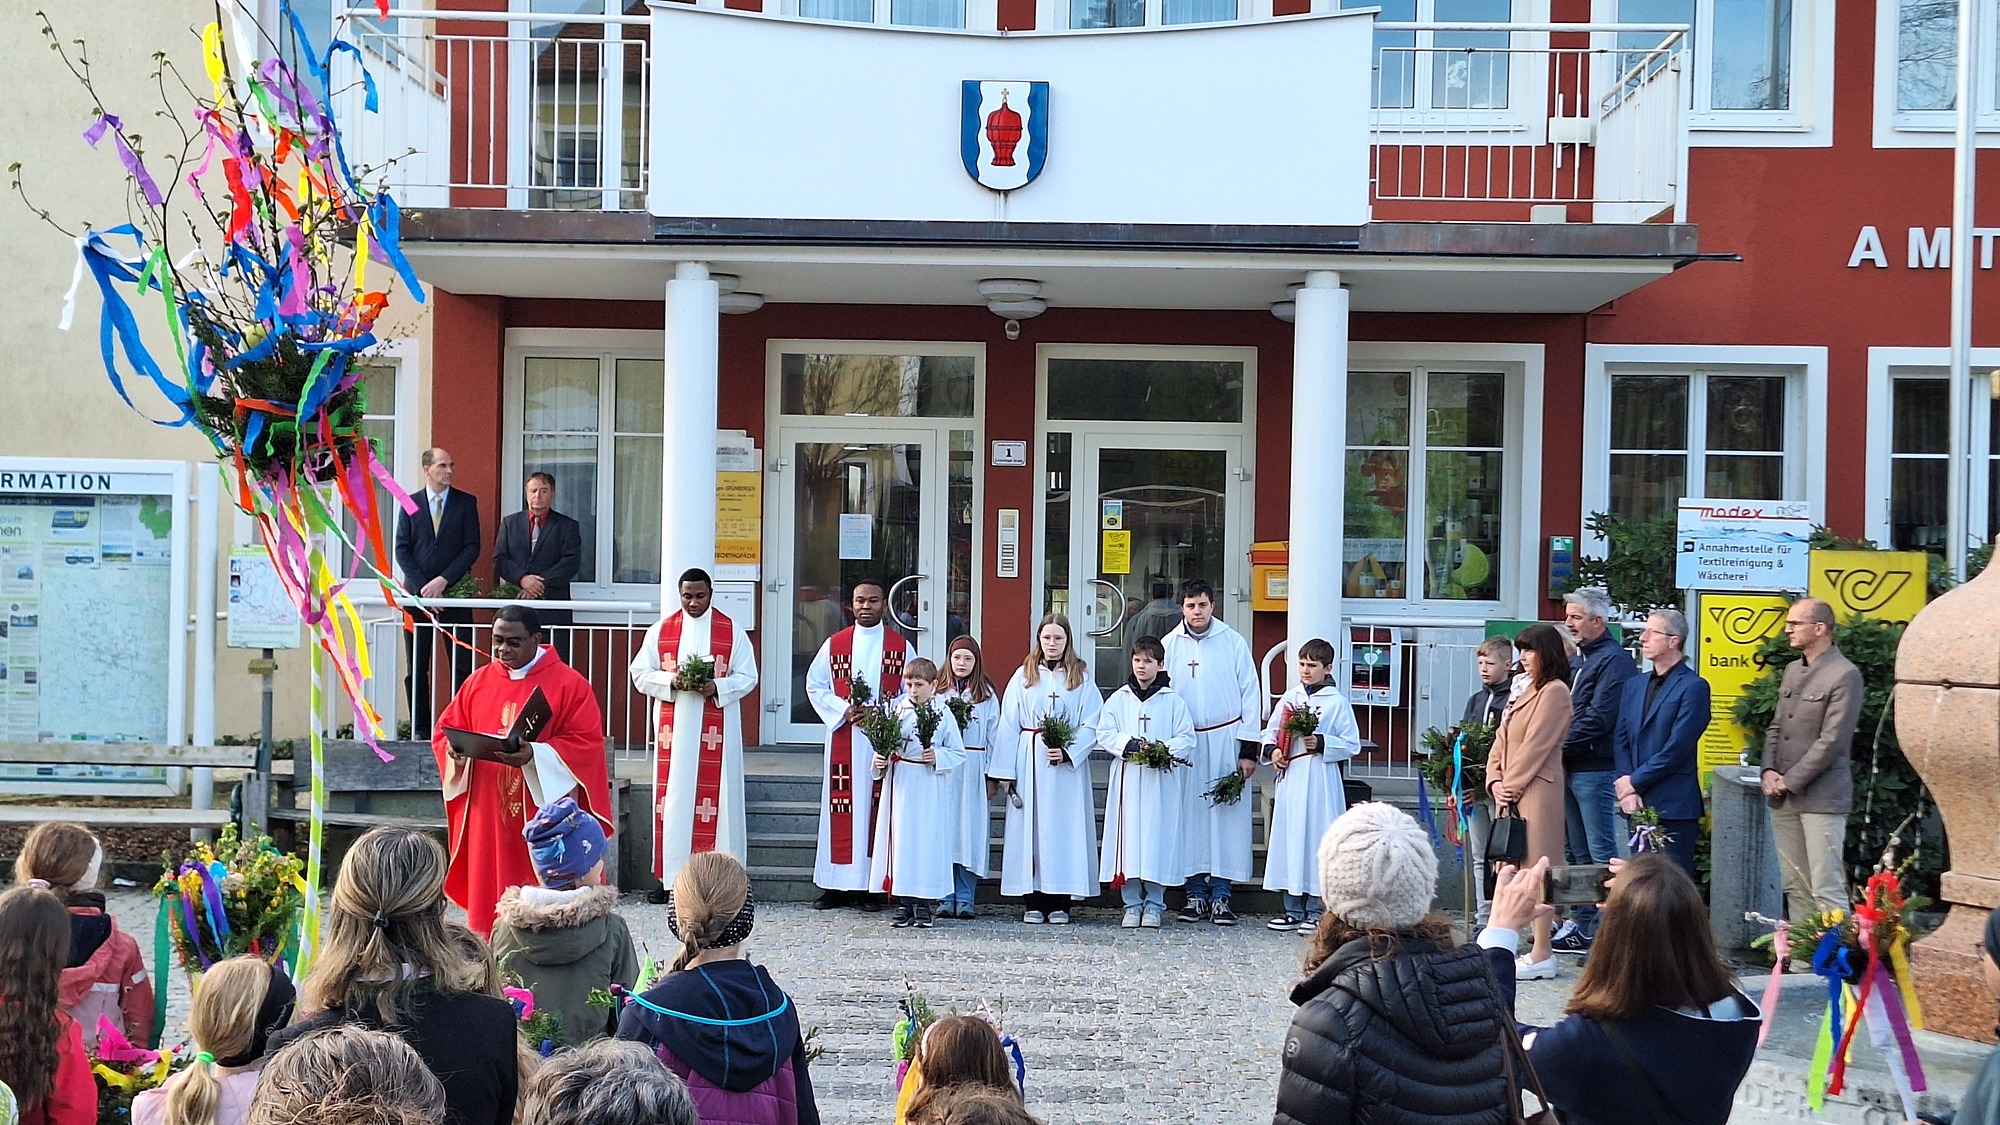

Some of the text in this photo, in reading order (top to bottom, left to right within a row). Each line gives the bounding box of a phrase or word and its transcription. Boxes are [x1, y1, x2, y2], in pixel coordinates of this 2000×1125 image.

[1006, 448, 1012, 458] 1
[1, 473, 111, 490] RMATION
[1700, 505, 1763, 519] modex
[1699, 542, 1792, 555] Annahmestelle für
[1698, 556, 1784, 570] Textilreinigung &
[1698, 570, 1748, 582] Wäscherei
